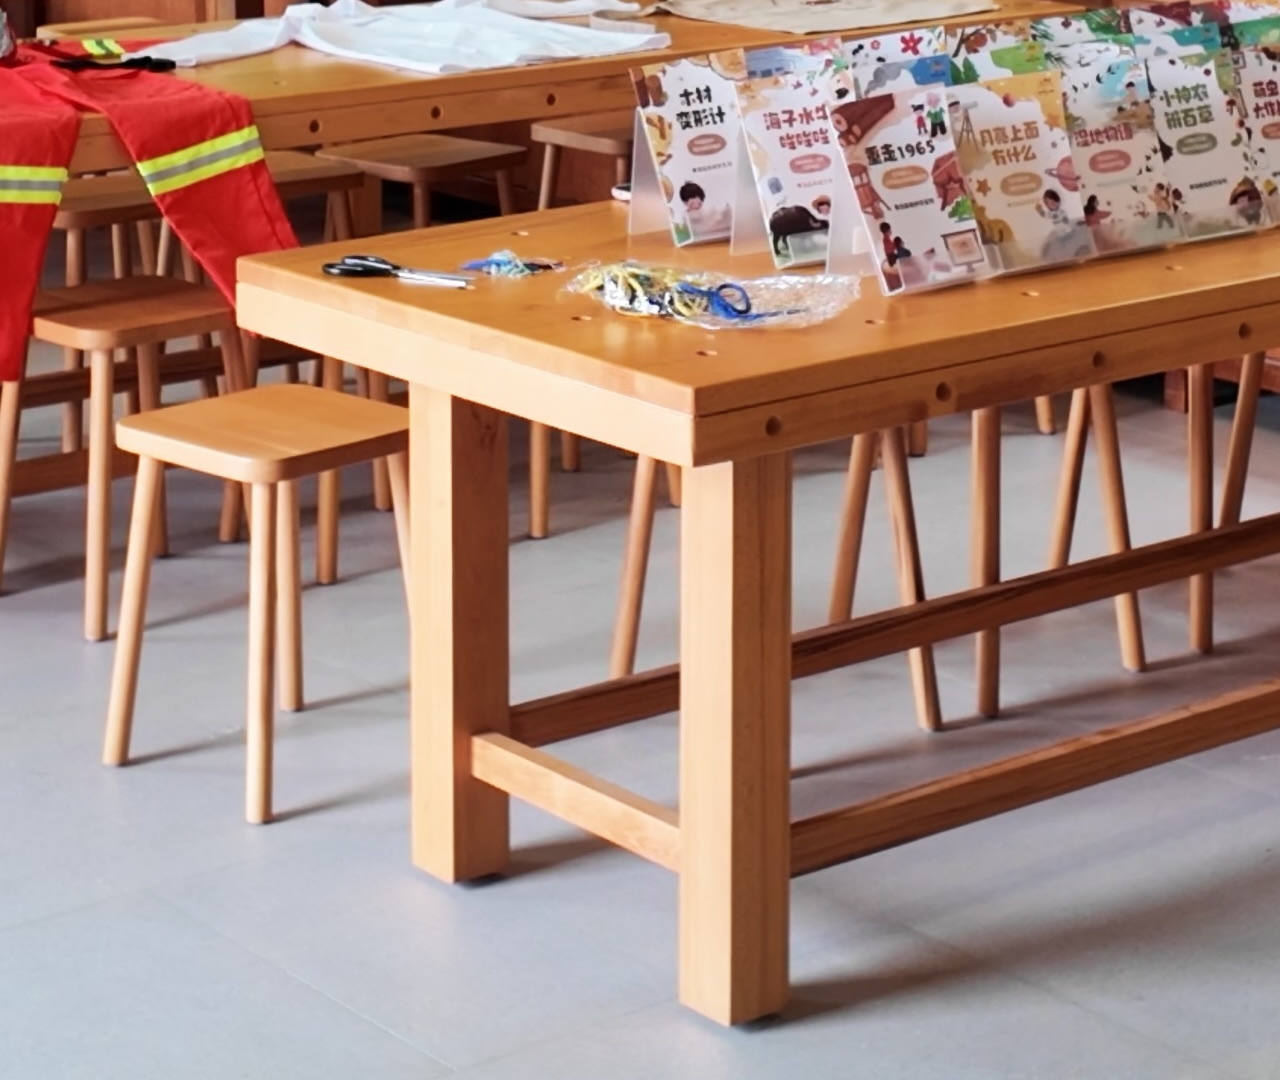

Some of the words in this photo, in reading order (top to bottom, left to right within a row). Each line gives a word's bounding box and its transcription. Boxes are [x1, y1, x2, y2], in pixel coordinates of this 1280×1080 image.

[679, 85, 713, 107] 木材
[979, 121, 1040, 147] 月亮上面
[865, 140, 936, 166] 重走1965
